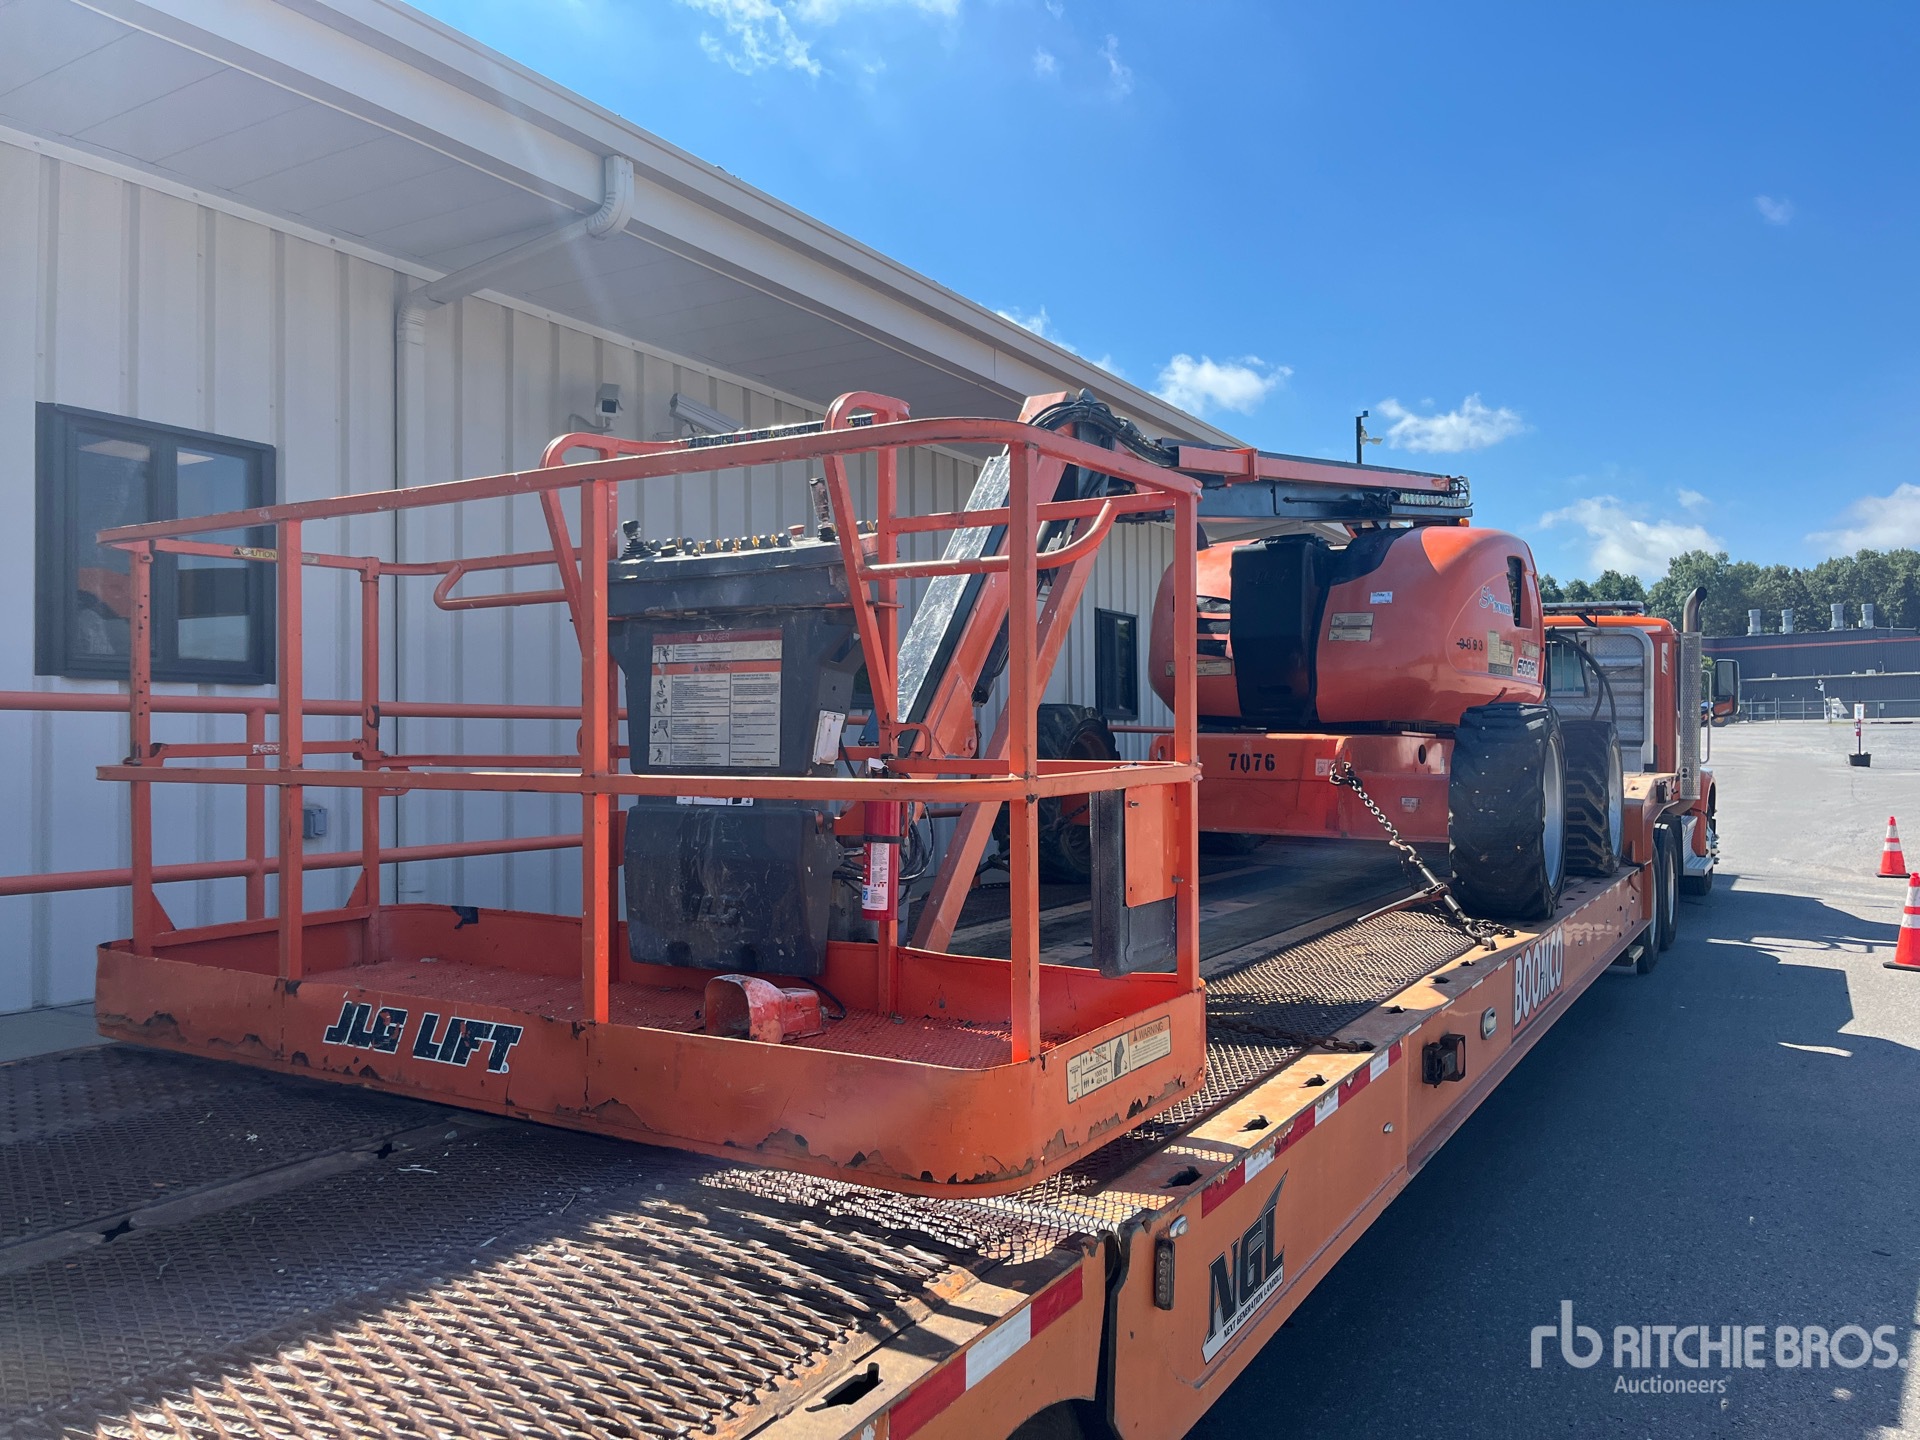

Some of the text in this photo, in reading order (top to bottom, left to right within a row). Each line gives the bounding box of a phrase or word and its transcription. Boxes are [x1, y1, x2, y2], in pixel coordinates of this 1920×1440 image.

[1228, 753, 1275, 773] 7076
[323, 1001, 523, 1074] JLG LIFT
[1138, 1021, 1164, 1040] WARNING
[1206, 1204, 1285, 1344] NGL
[1223, 1270, 1283, 1339] NEXT GENERATION LANDOLL
